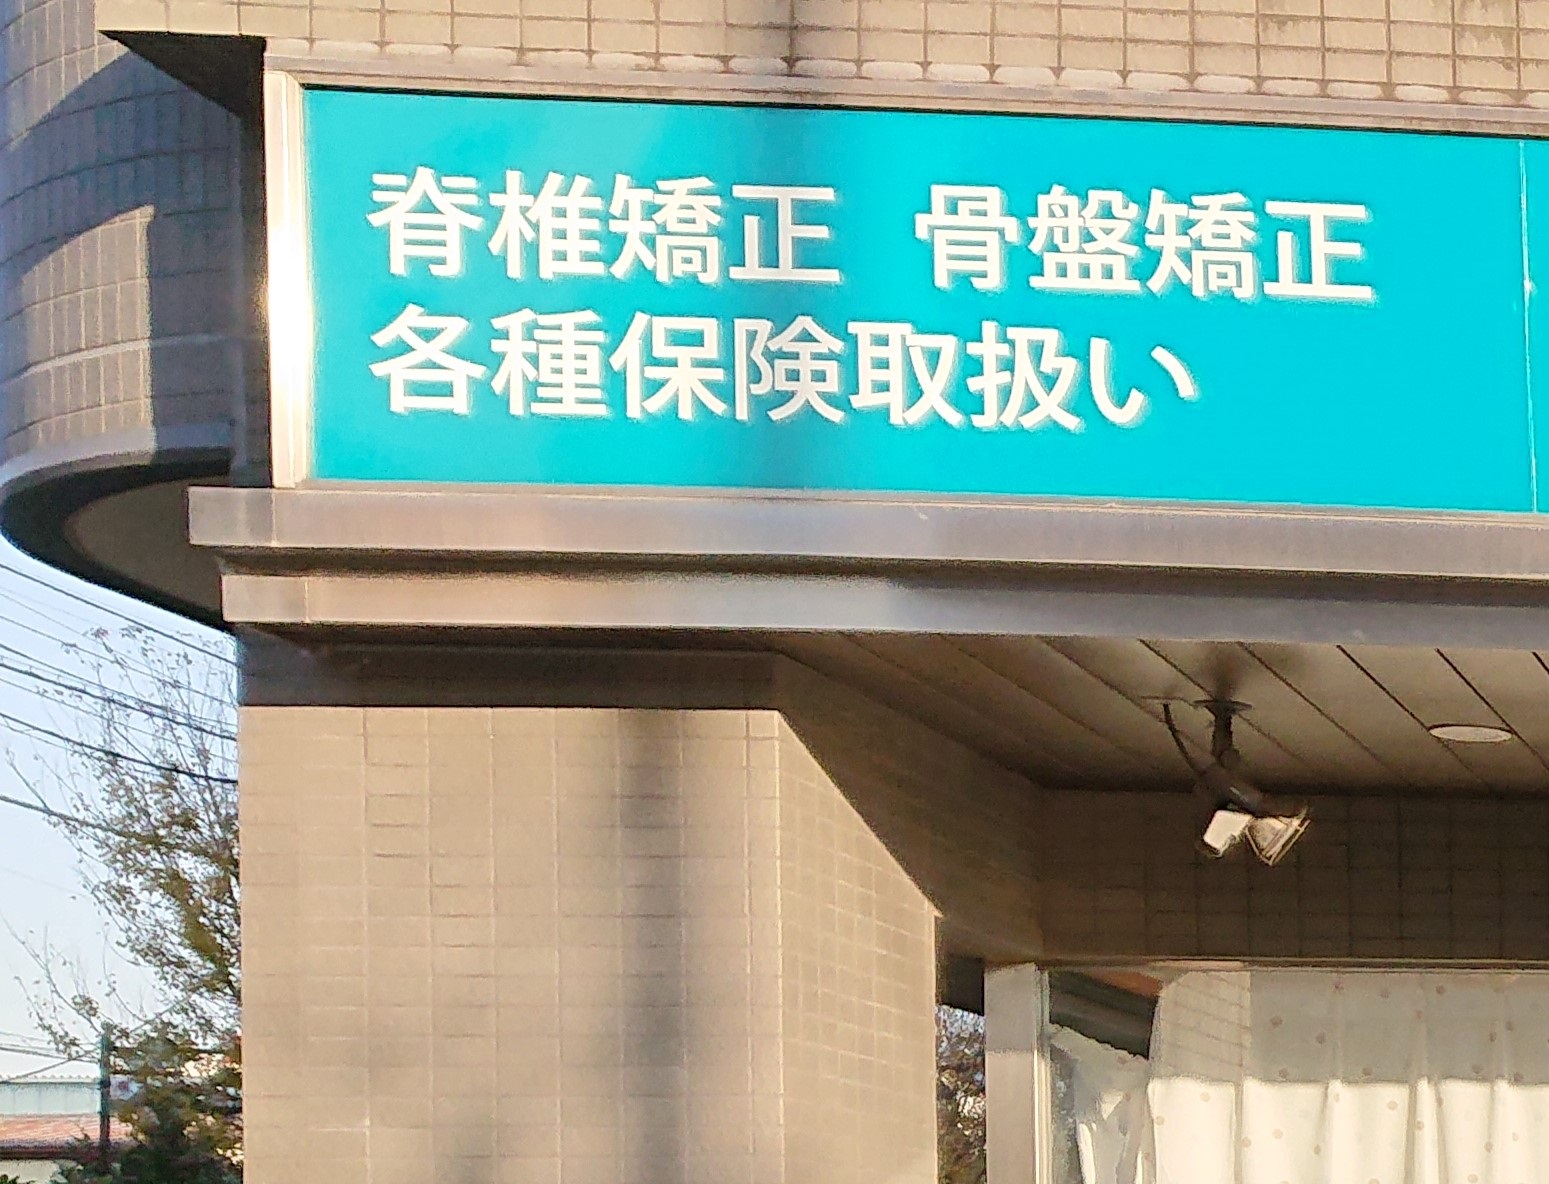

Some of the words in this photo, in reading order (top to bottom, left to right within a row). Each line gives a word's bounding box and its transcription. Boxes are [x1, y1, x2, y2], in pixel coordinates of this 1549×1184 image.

[367, 167, 840, 284] 脊椎矯正
[916, 184, 1374, 302] 骨盤矯正
[369, 306, 1195, 430] 各種保険取扱い
